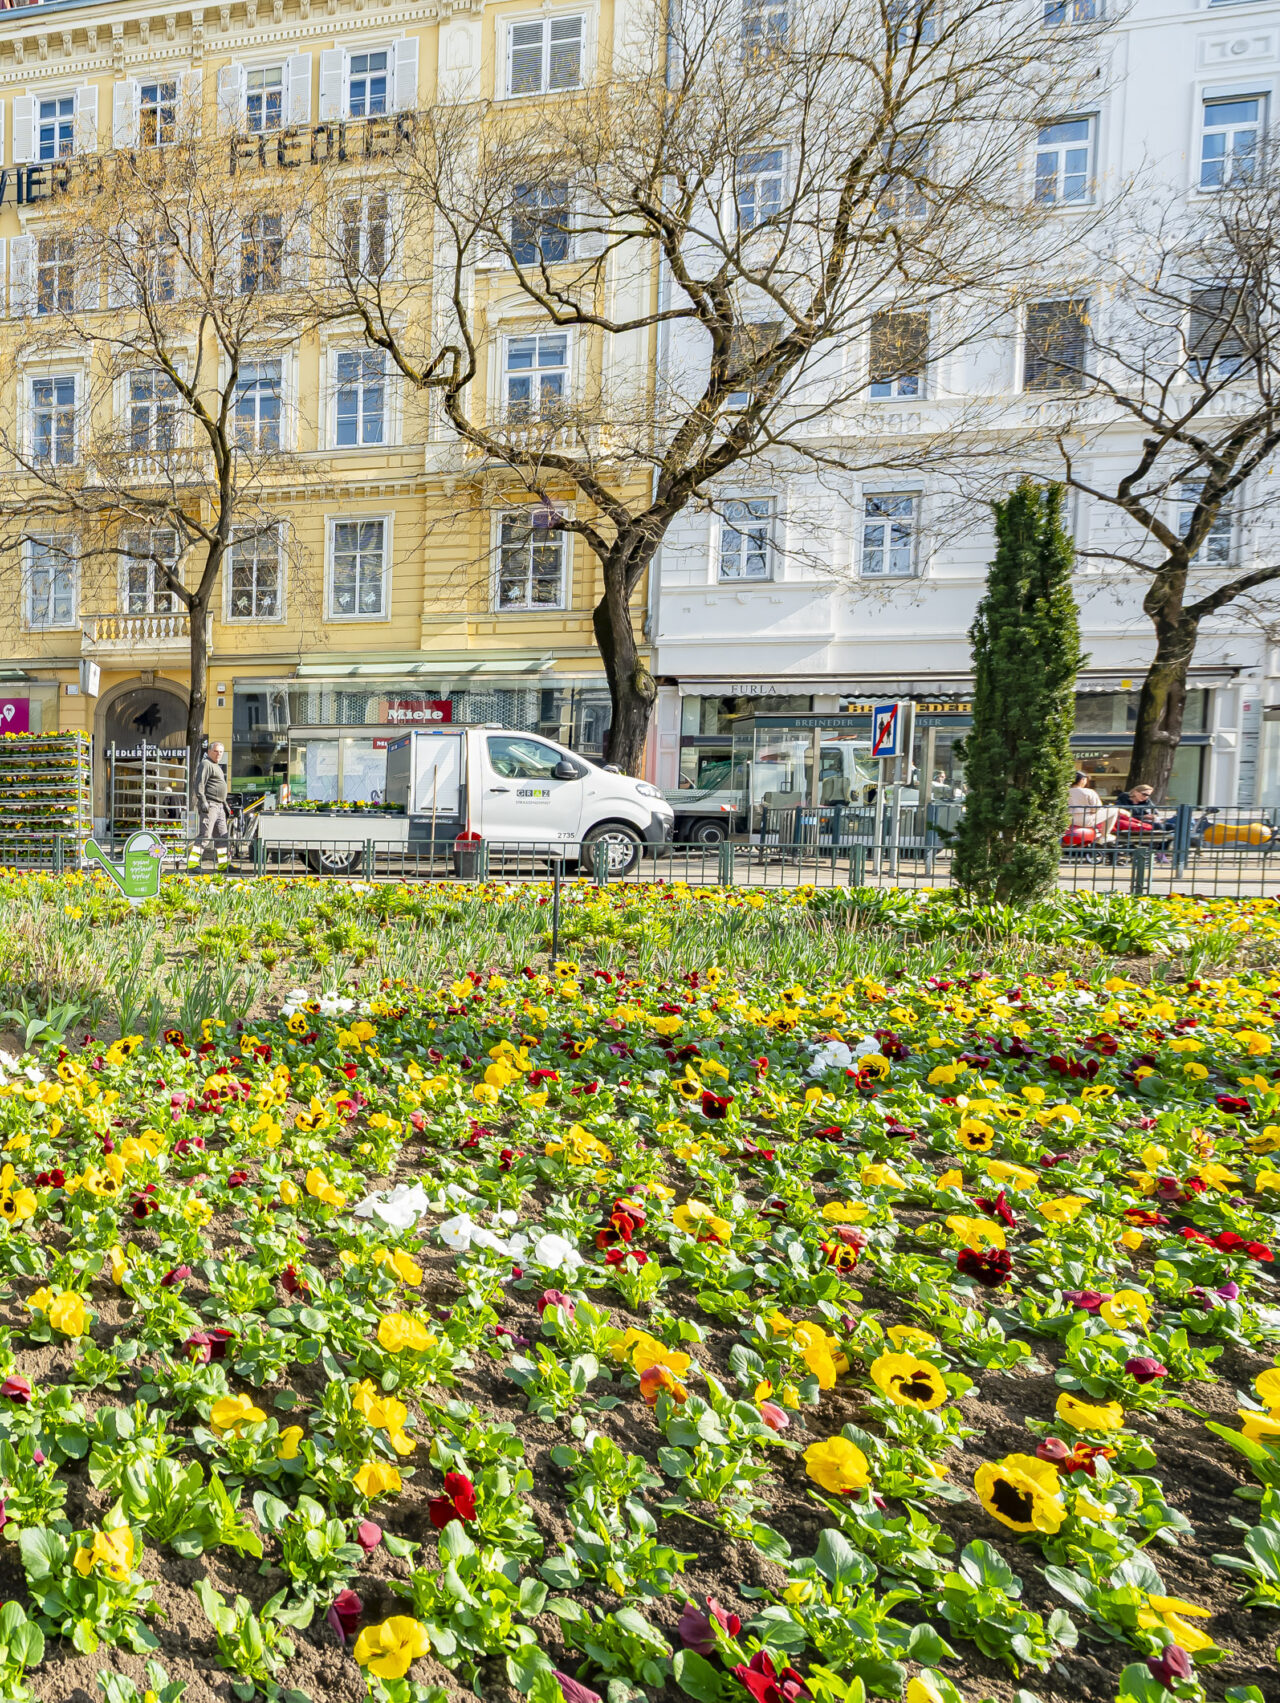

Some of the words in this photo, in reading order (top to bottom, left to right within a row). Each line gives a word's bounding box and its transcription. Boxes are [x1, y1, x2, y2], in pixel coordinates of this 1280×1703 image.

[730, 684, 777, 694] FURLA
[848, 703, 973, 713] BREDER
[387, 708, 444, 721] Miele
[795, 719, 854, 727] BREINEDER
[106, 749, 142, 757] FEDLER
[516, 789, 551, 798] GRAZ
